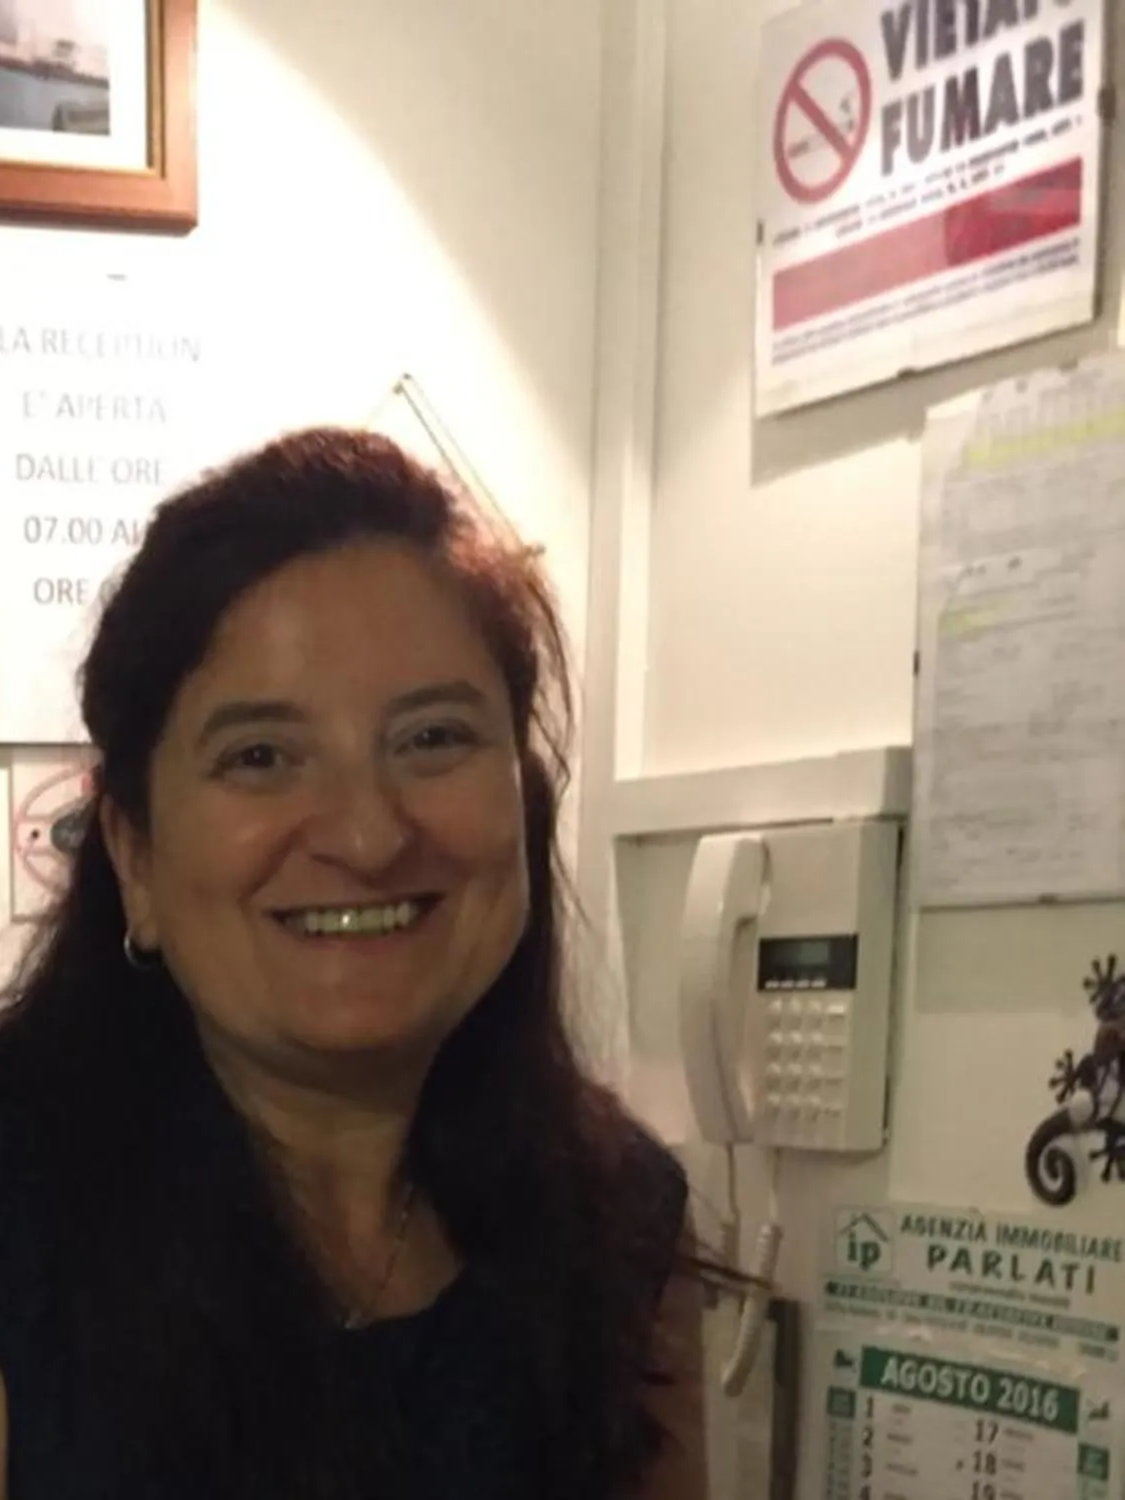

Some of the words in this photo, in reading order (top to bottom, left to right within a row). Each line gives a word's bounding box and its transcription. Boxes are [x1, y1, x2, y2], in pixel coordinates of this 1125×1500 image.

[880, 0, 1075, 82] VIETA
[880, 18, 1085, 177] FUMARE
[15, 453, 97, 484] DALLE
[23, 515, 103, 545] 07.00
[33, 578, 89, 606] ORE
[900, 1215, 987, 1243] AGENZIA
[996, 1222, 1123, 1263] IMMOBILIARE
[927, 1245, 1096, 1295] PARLATI
[880, 1356, 990, 1403] AGOSTO
[997, 1380, 1059, 1422] 2016
[975, 1419, 999, 1444] 17
[974, 1450, 996, 1475] 18
